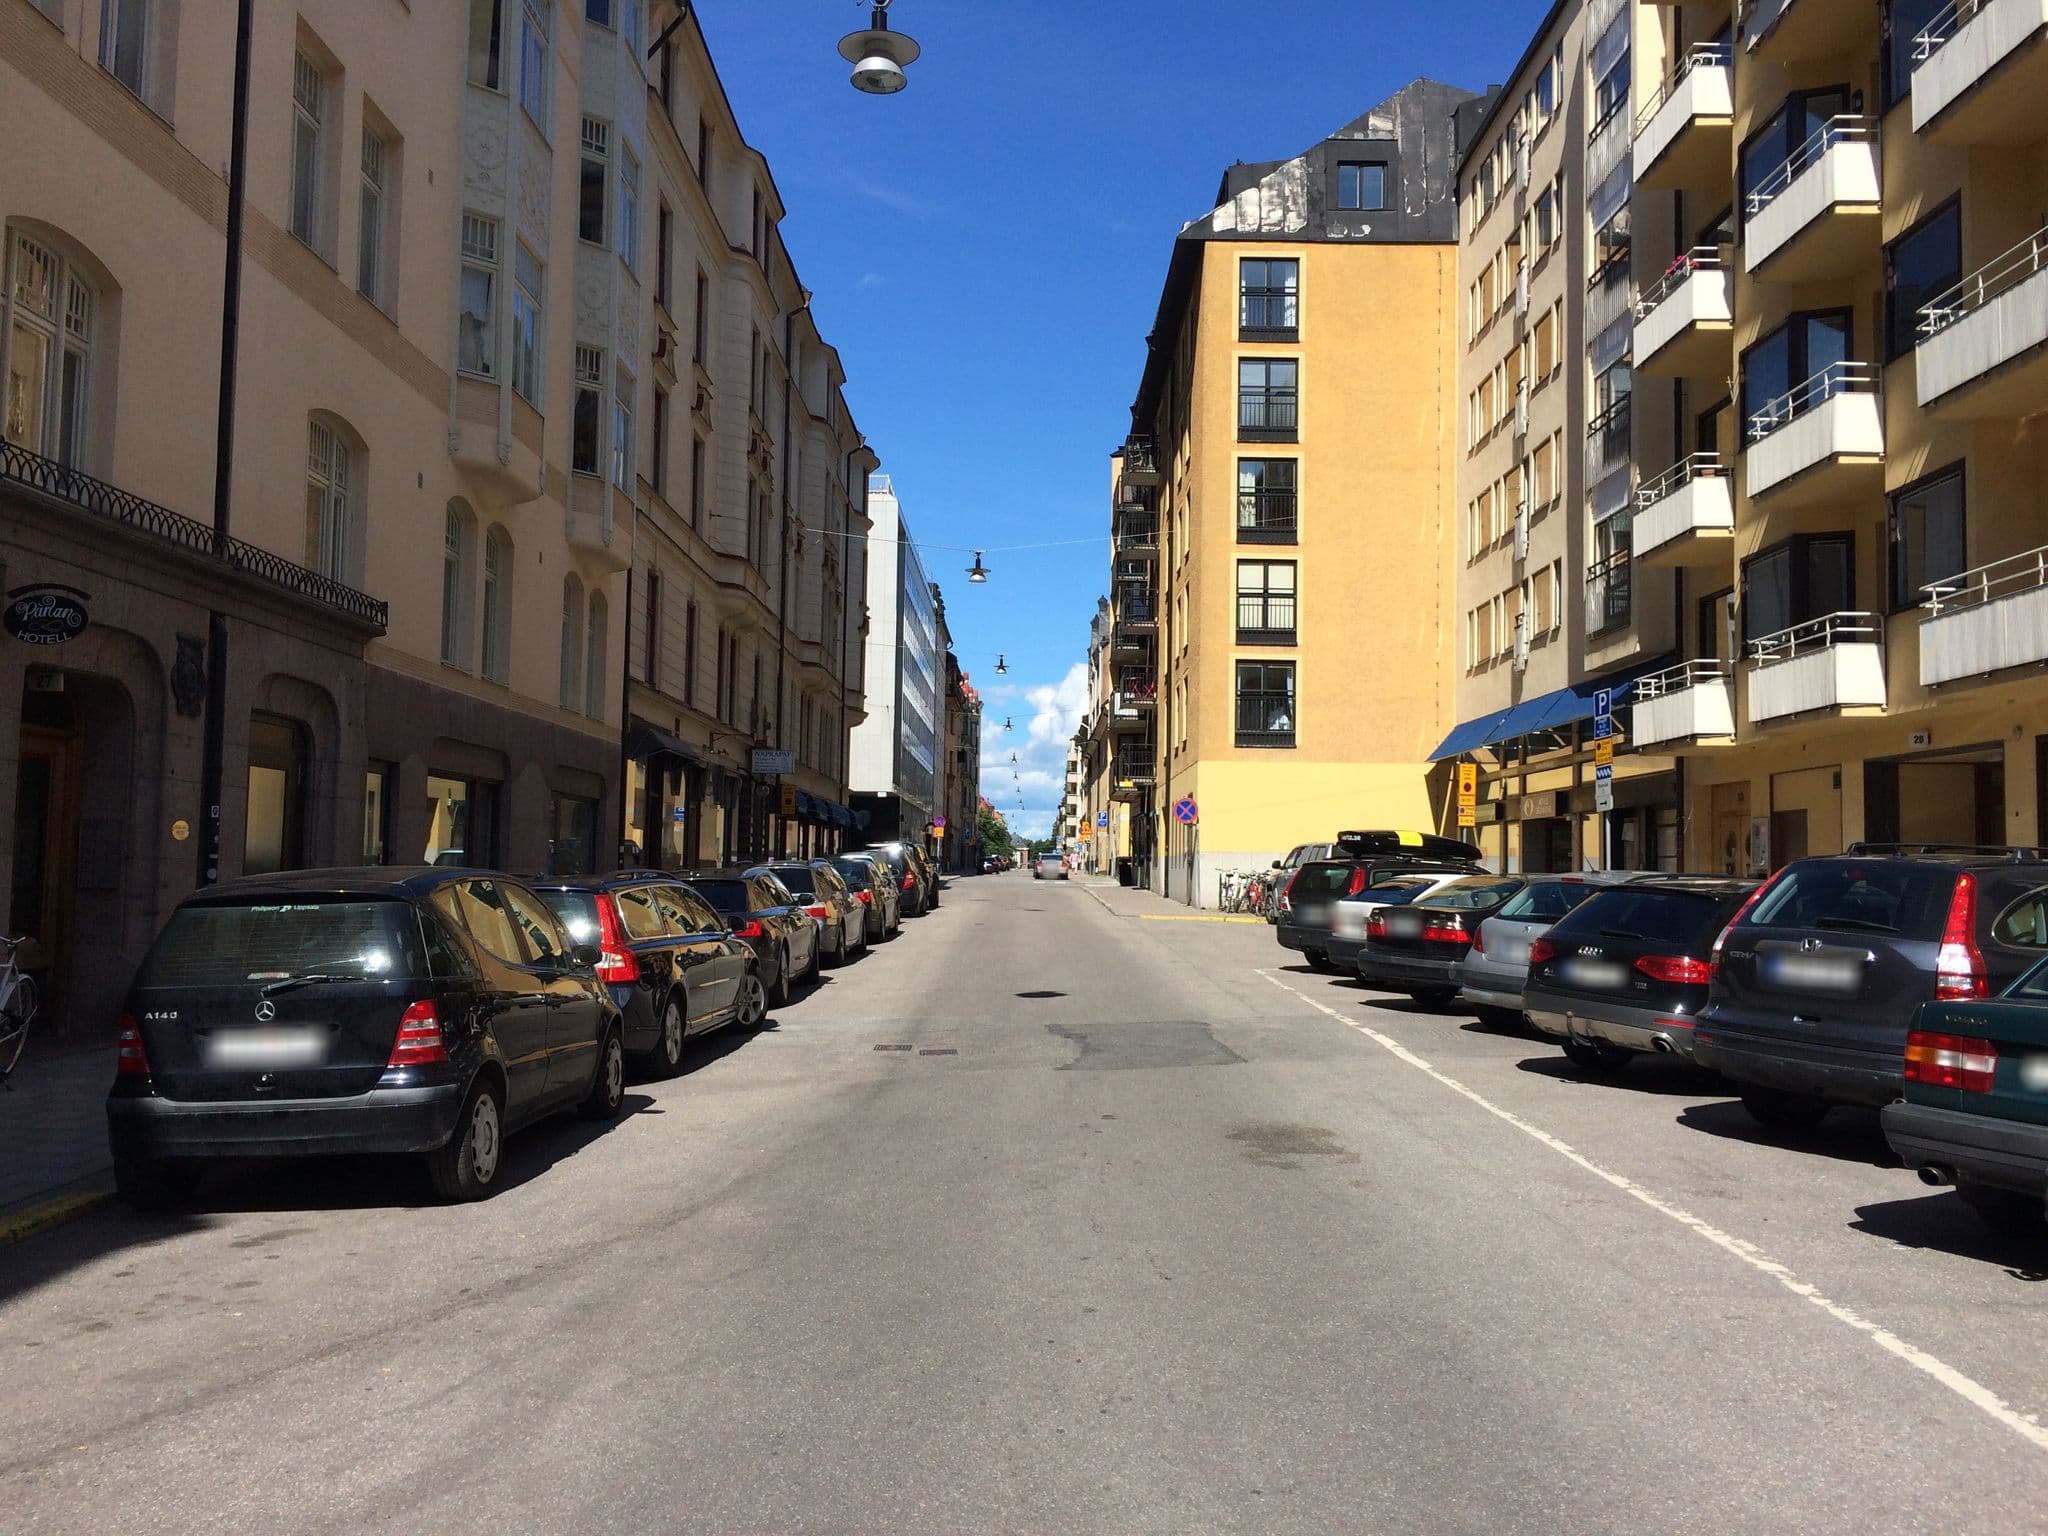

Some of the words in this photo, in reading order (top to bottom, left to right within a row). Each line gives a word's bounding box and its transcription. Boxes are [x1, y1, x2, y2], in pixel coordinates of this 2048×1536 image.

[17, 630, 72, 645] HOTELL
[1598, 692, 1608, 715] P
[144, 1011, 178, 1020] A140
